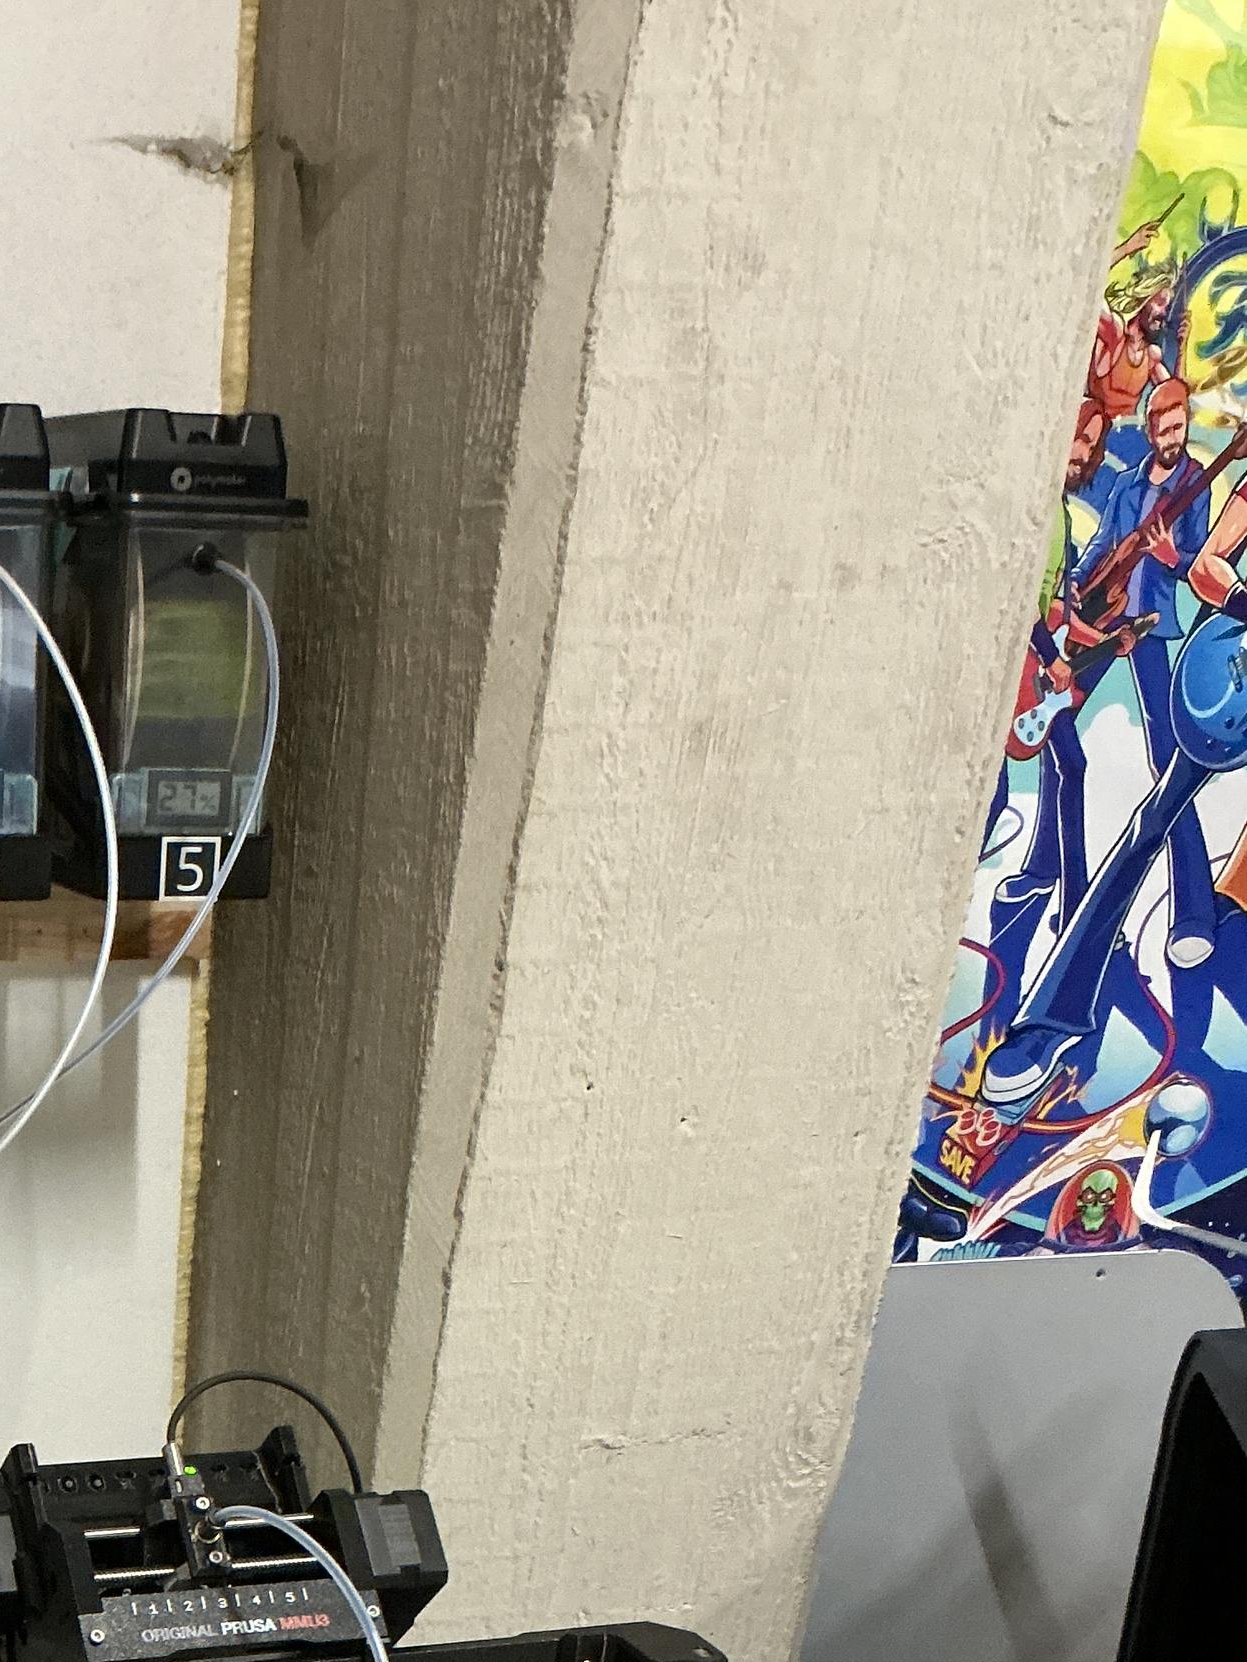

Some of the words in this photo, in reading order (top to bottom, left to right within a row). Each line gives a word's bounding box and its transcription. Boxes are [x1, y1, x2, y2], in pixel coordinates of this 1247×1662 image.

[176, 846, 203, 892] 5
[940, 1139, 975, 1184] SAVE
[148, 1602, 159, 1614] 1
[183, 1599, 194, 1612] 2
[217, 1597, 228, 1609] 3
[252, 1594, 262, 1606] 4
[285, 1591, 297, 1603] 5
[141, 1622, 218, 1643] ORIGINAL
[220, 1618, 277, 1637] PRUSA
[279, 1613, 331, 1631] MMU3
